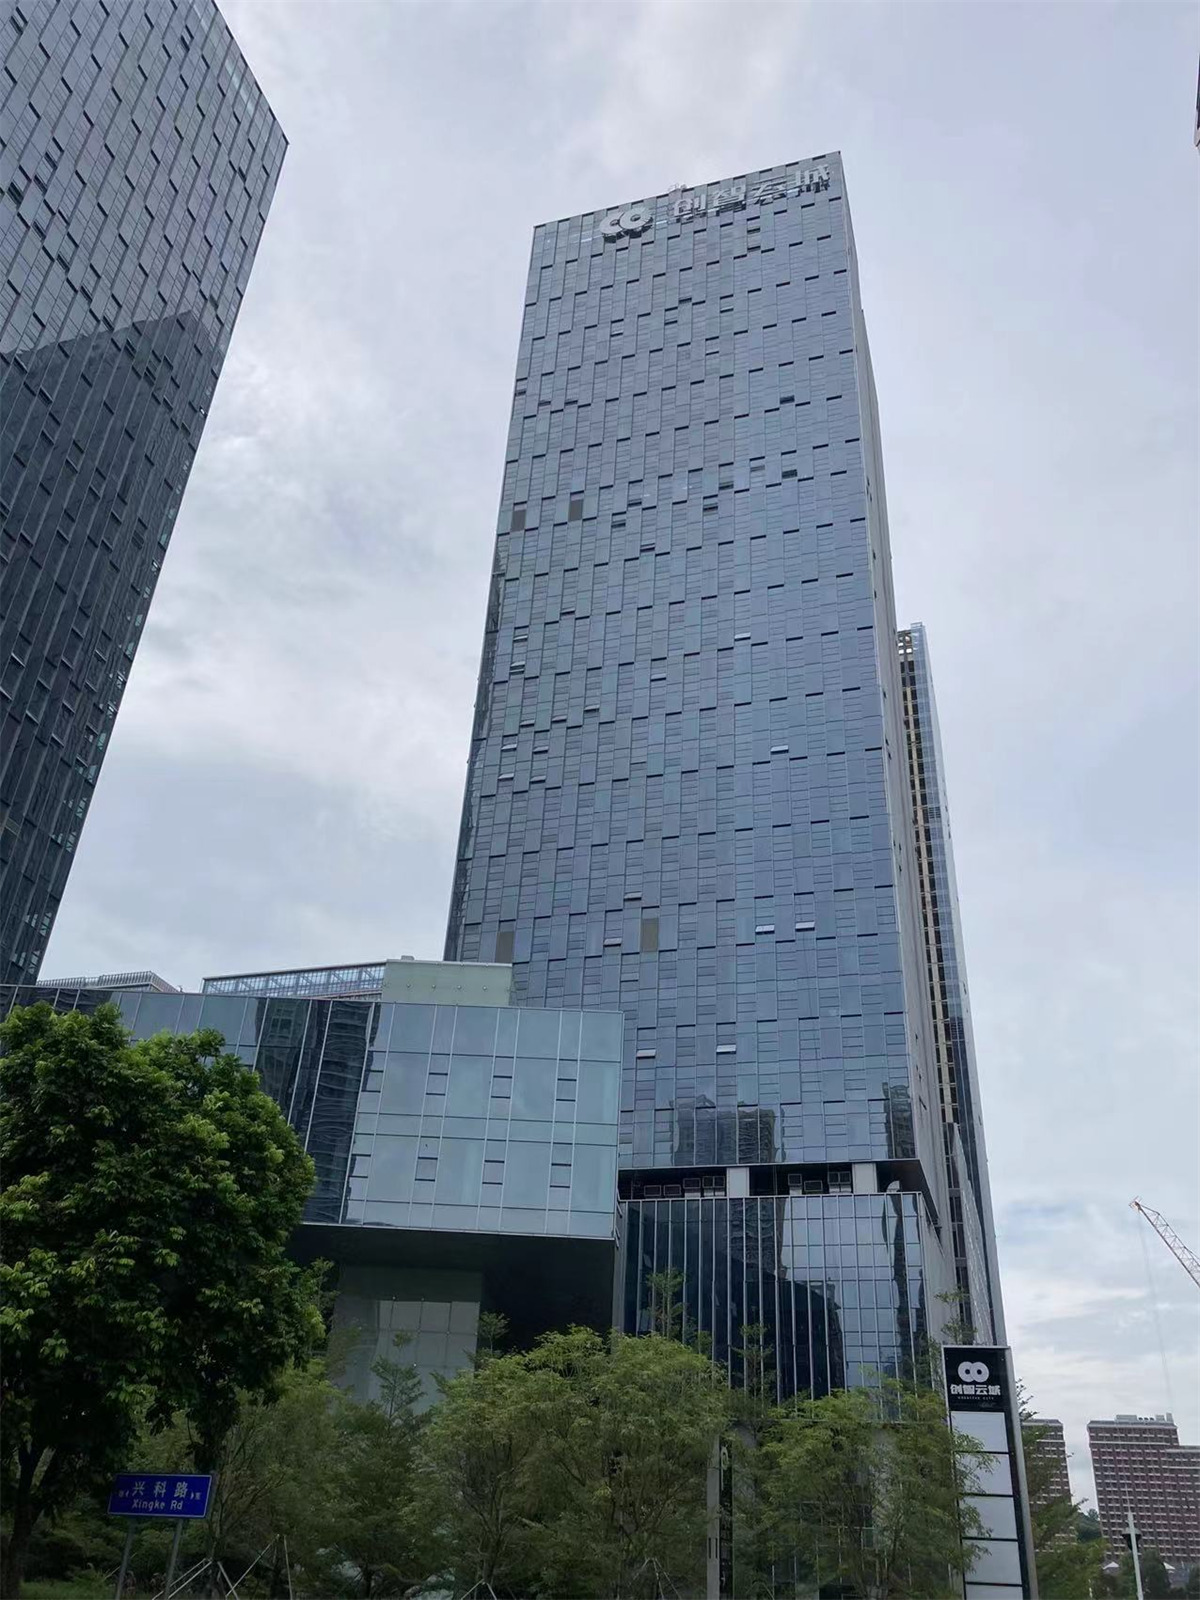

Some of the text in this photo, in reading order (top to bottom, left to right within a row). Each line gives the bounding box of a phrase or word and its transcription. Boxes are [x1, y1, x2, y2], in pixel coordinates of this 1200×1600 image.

[673, 164, 831, 218] 创智云城
[132, 1481, 188, 1498] 兴科路
[132, 1499, 183, 1512] Xingke Rd
